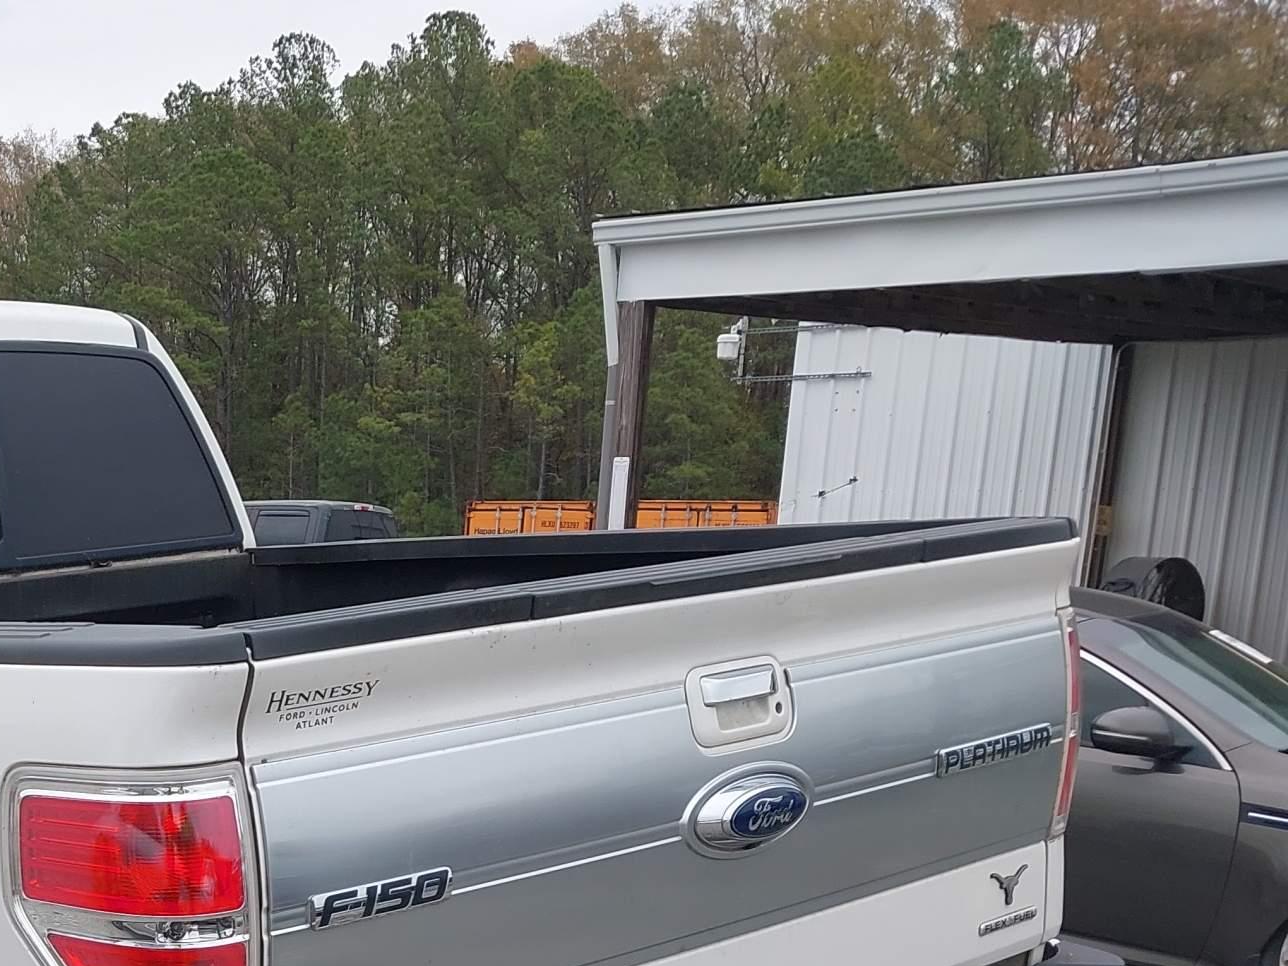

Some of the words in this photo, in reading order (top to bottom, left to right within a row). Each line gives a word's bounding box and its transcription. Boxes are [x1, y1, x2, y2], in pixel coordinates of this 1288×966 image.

[265, 680, 380, 713] HENNESSY
[279, 710, 306, 722] FORD
[315, 702, 359, 716] LINCOLN
[295, 716, 335, 730] ATLANT
[942, 726, 1052, 774] PLATINUM
[748, 795, 795, 831] Ford
[317, 869, 451, 928] F-150
[984, 918, 1008, 933] FLEX
